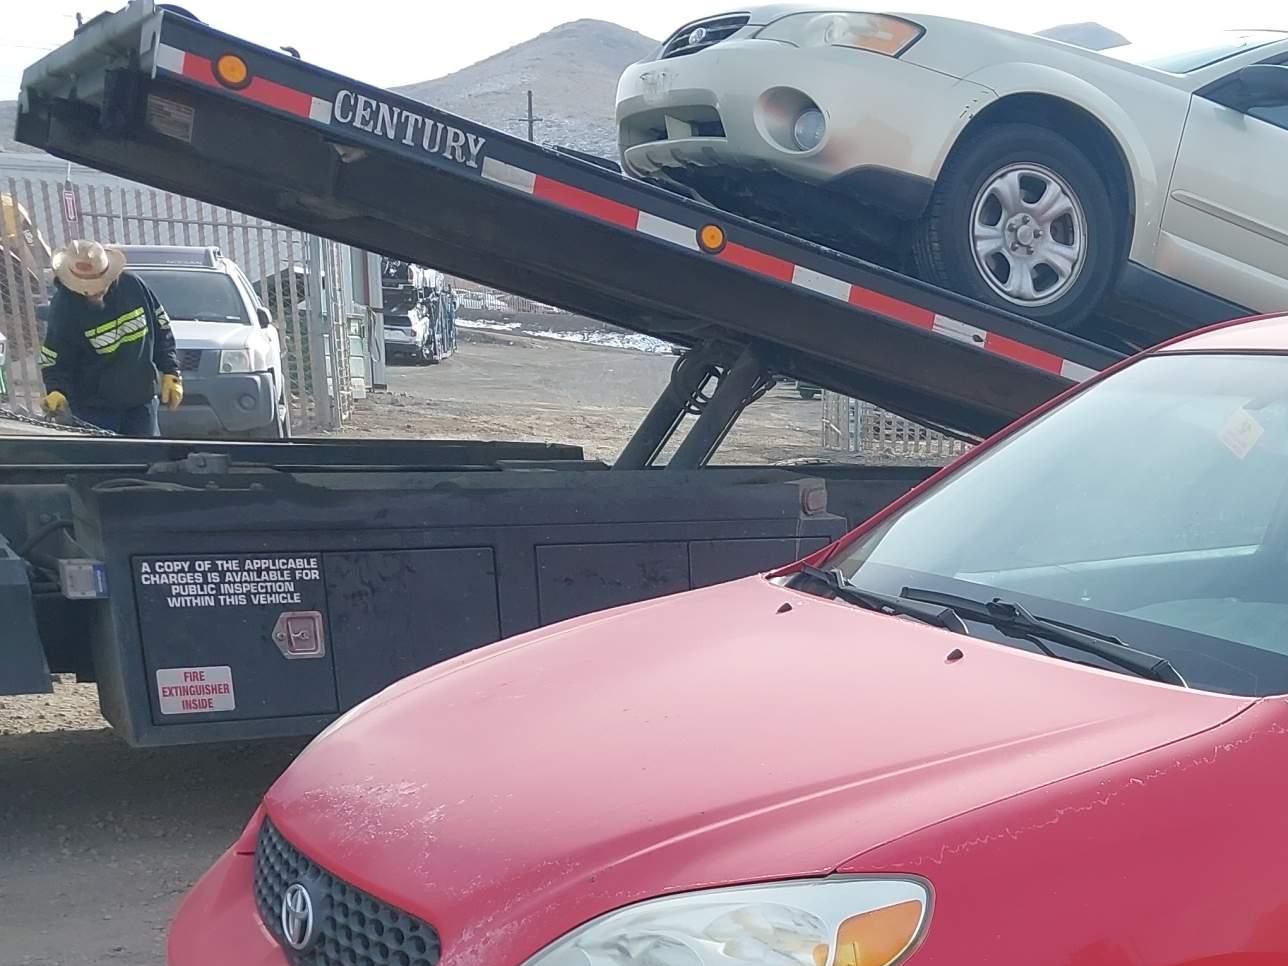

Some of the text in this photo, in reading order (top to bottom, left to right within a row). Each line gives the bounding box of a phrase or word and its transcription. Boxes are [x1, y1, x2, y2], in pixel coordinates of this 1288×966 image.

[334, 89, 487, 168] CENTURY
[141, 558, 318, 573] A COPY OF THE APPLICABLE
[141, 570, 320, 585] CHARGES IS AVAILABLE FOR
[171, 582, 295, 596] PUBLIC INSPECTION
[167, 593, 301, 607] WITHIN THIS VEHICLE
[183, 671, 205, 682] FIRE
[161, 683, 230, 697] EXTINGUISHER
[182, 698, 214, 710] INSIDE
